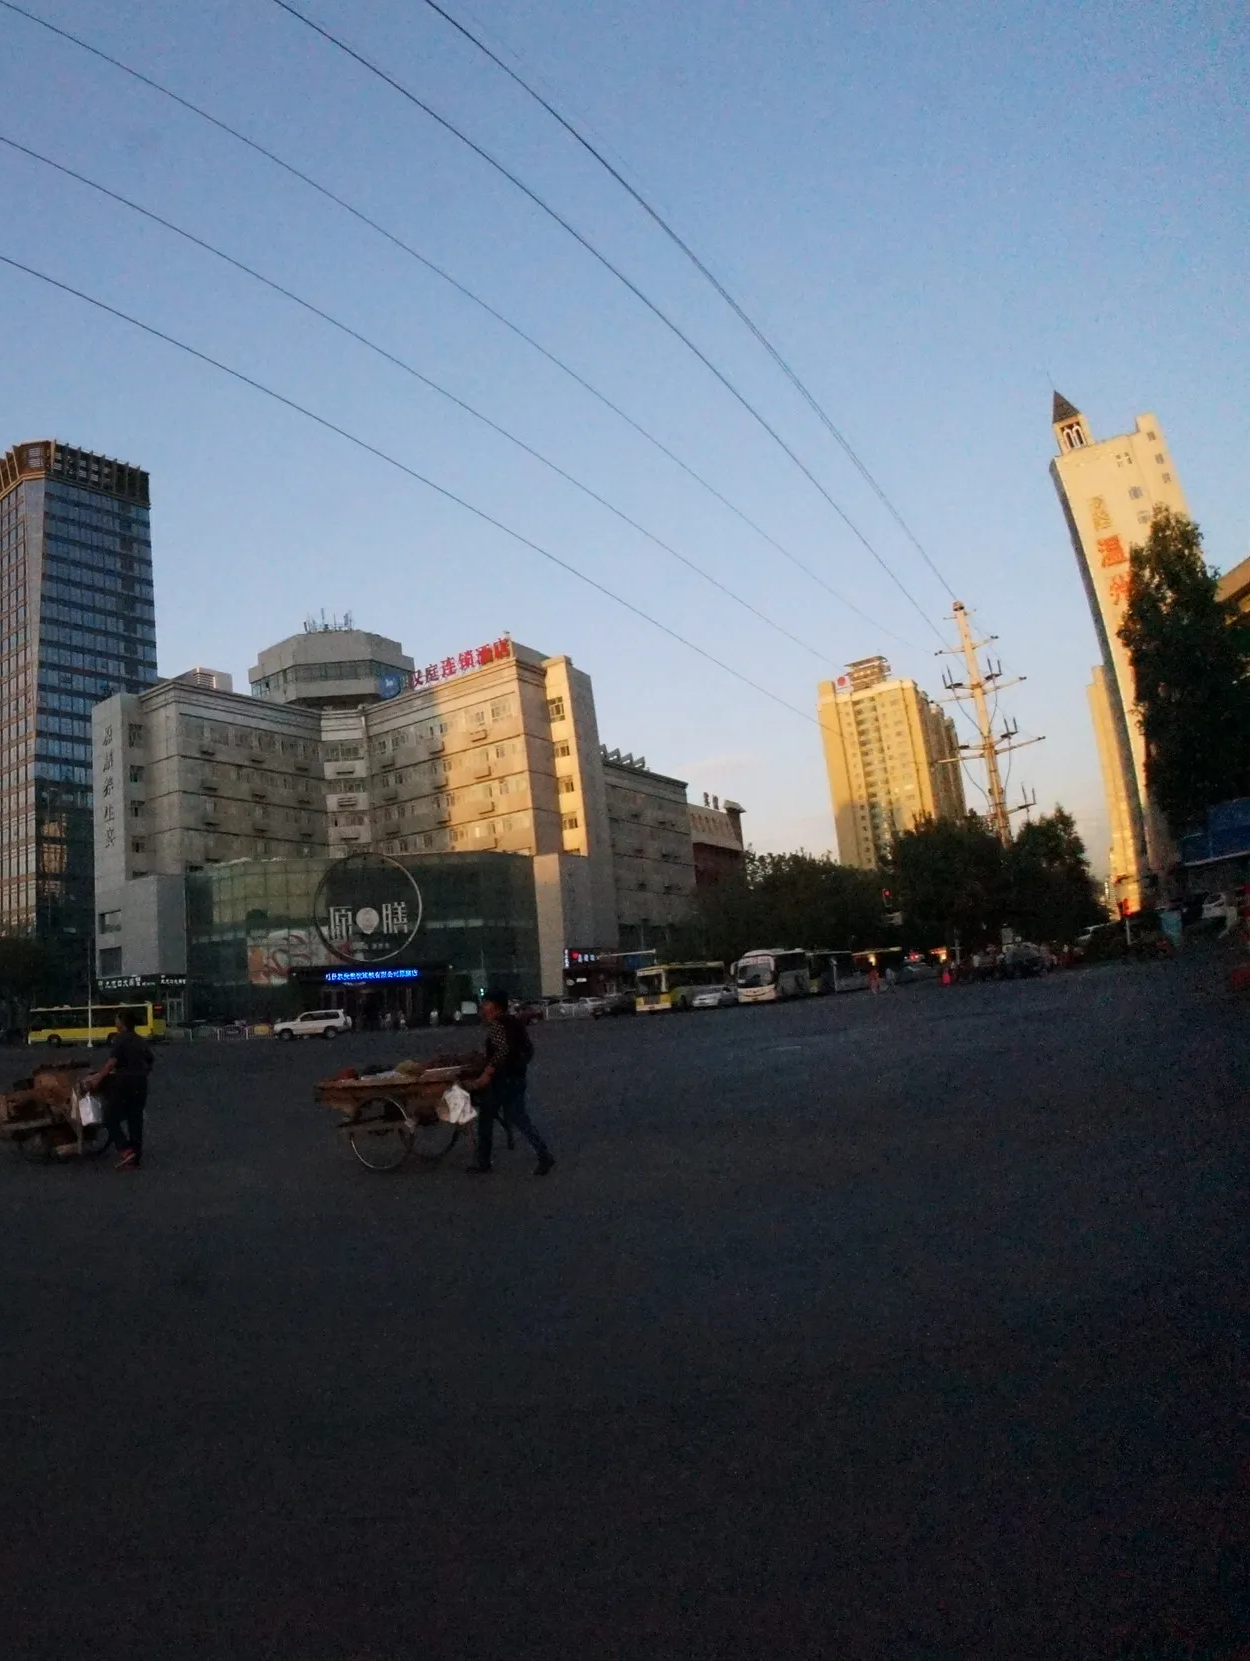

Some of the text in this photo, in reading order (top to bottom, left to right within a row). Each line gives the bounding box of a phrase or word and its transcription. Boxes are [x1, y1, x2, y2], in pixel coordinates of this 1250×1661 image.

[408, 638, 511, 690] 汉庭连锁酒店
